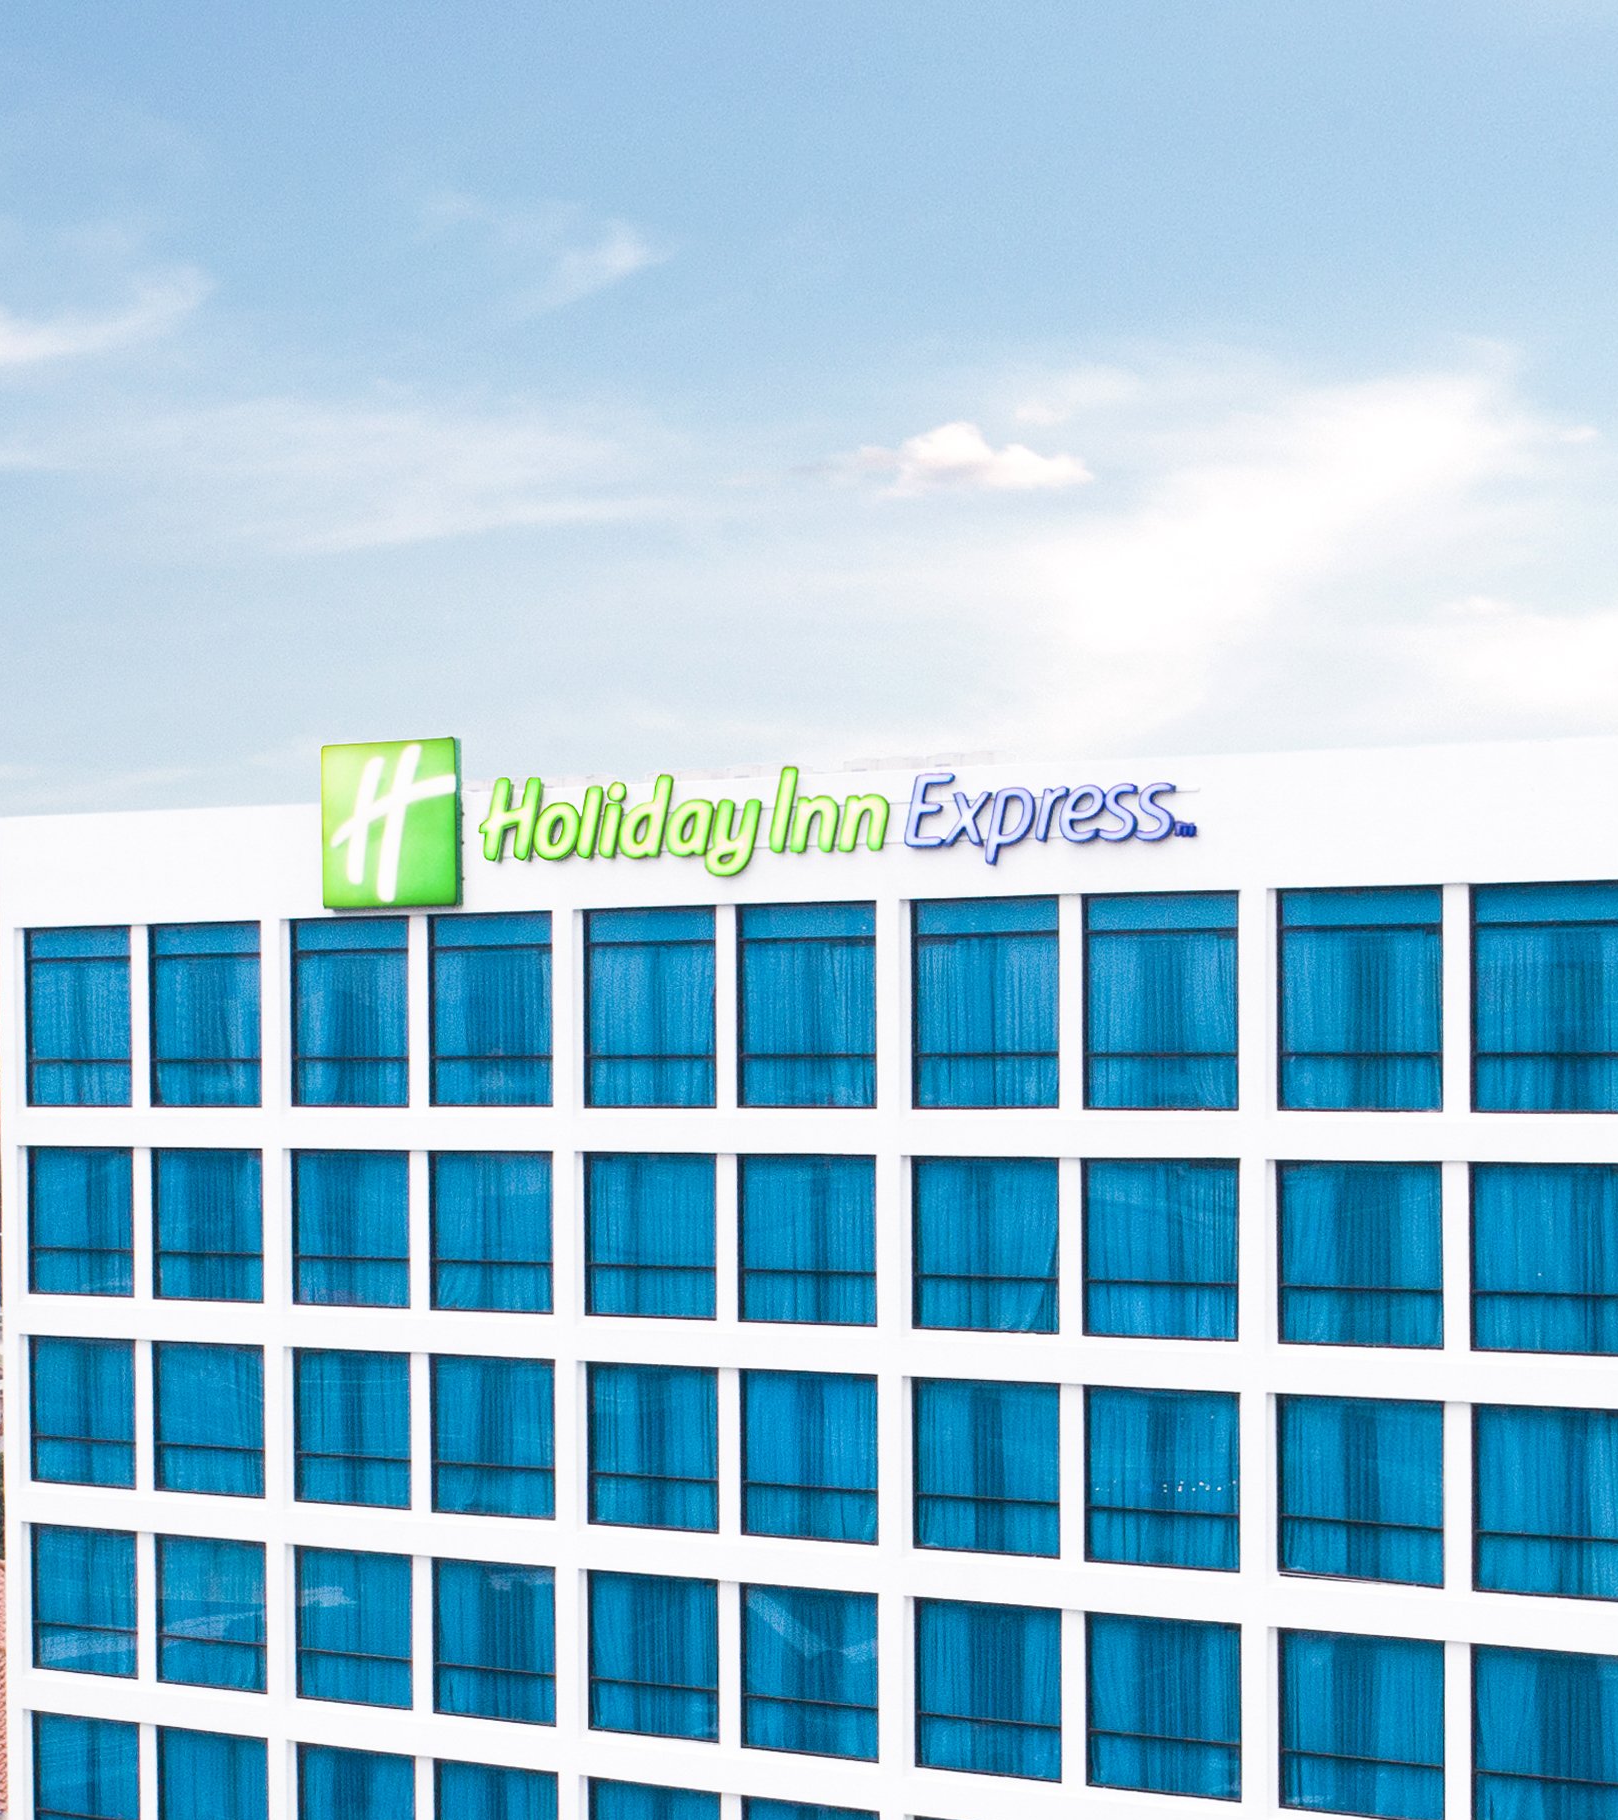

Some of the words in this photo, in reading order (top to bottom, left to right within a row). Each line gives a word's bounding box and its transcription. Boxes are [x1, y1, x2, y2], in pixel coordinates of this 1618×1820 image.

[477, 772, 762, 878] Holiday
[771, 765, 890, 854] Inn
[903, 771, 1178, 867] Express
